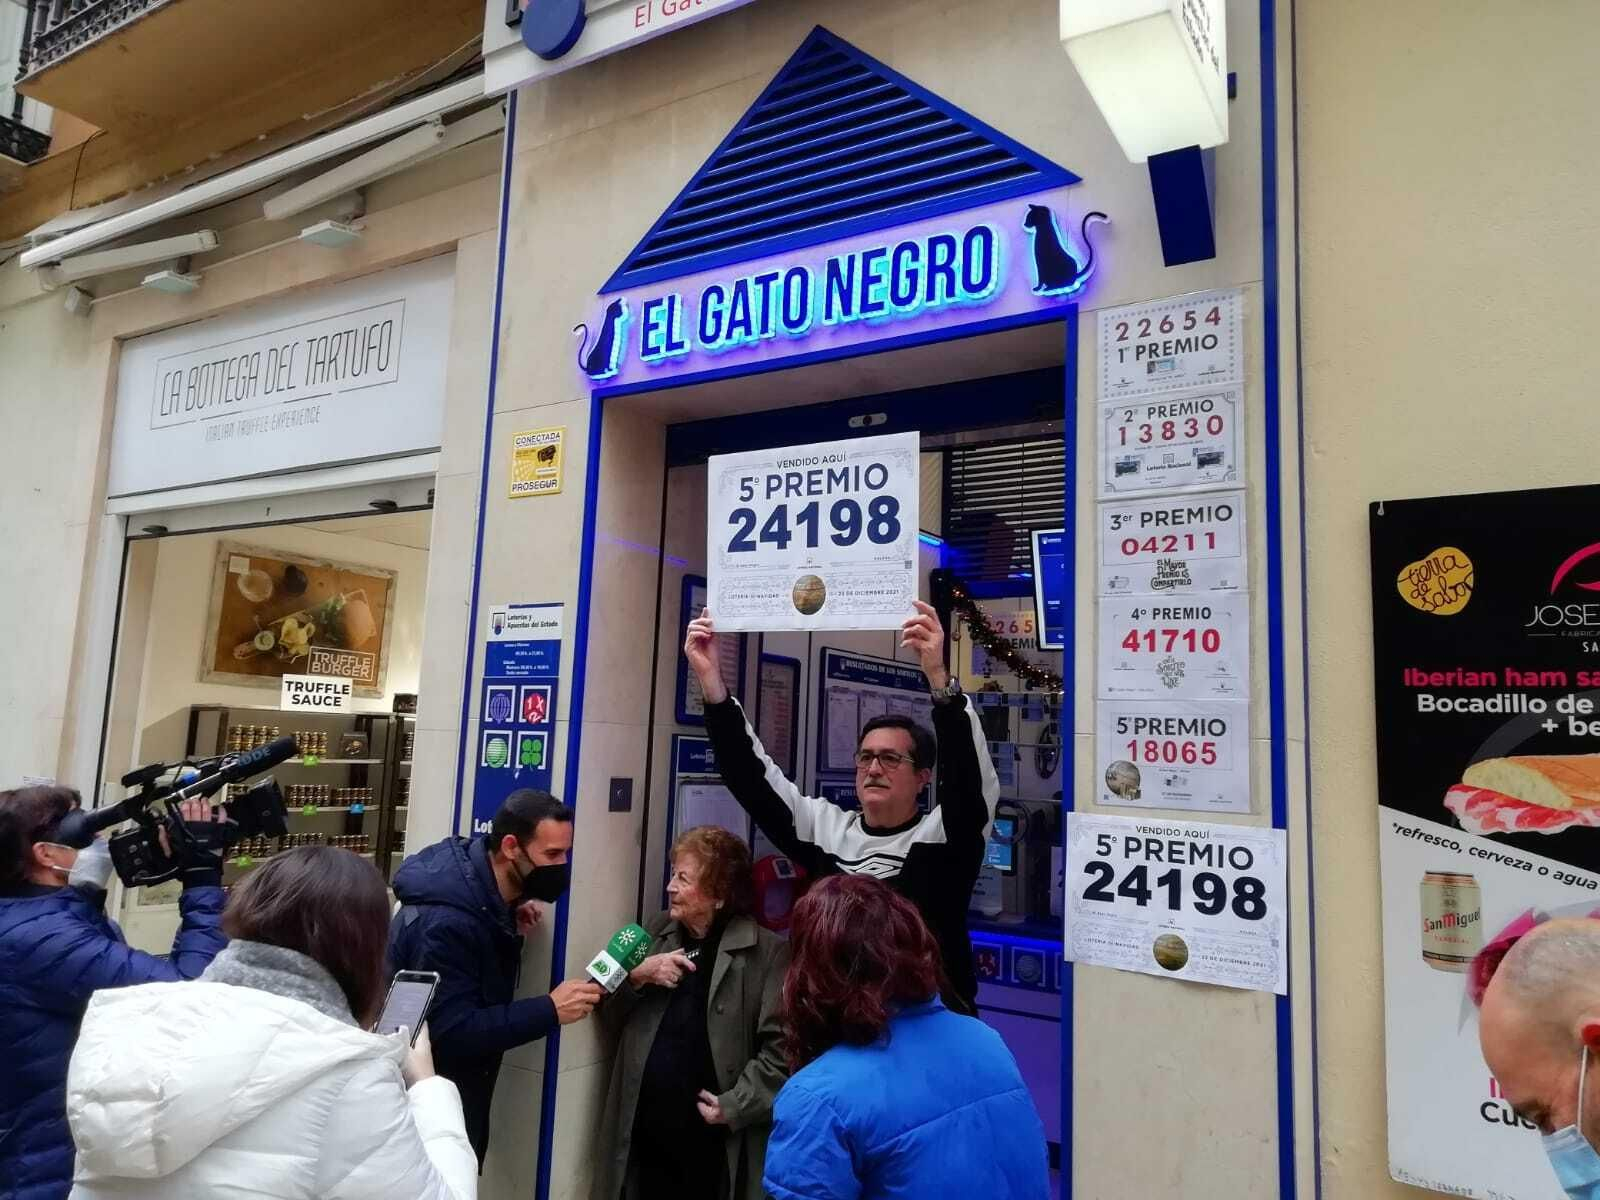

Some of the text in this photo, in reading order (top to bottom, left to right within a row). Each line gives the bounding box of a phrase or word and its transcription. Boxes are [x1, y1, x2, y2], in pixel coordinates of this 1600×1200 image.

[634, 0, 652, 28] El
[641, 225, 993, 358] EL GATO NEGRO
[1115, 306, 1221, 342] 22654
[1135, 333, 1219, 361] PREMIO
[185, 352, 260, 411] BOTTEGA
[264, 342, 299, 394] DEL
[305, 319, 393, 386] TARTUFO
[1147, 399, 1214, 420] PREMIO
[515, 431, 560, 445] CONECTADA
[1118, 414, 1224, 446] 13830
[776, 456, 819, 470] VENDIDO
[512, 479, 557, 492] PROSEGUR
[766, 462, 888, 499] PREMIO
[727, 495, 901, 553] 24198
[1141, 504, 1233, 528] PREMIO
[1121, 532, 1215, 556] 04211
[1402, 554, 1469, 587] tierra
[1152, 606, 1212, 620] PREMIO
[1122, 628, 1221, 653] 41710
[311, 651, 371, 669] TRUFFLE
[311, 661, 369, 678] BURGER
[285, 680, 351, 695] TRUFFLE
[1404, 667, 1496, 688] Iberian
[1505, 667, 1568, 688] ham
[291, 694, 343, 707] SAUCE
[1417, 694, 1594, 714] Bocadillo de
[1133, 716, 1226, 737] PREMIO
[1127, 739, 1217, 765] 18065
[1135, 824, 1210, 840] VENDIDO AQUÍ
[1124, 836, 1254, 871] PREMIO
[1468, 846, 1533, 872] cerveza
[1537, 865, 1549, 876] o
[1553, 870, 1598, 891] agua
[1081, 860, 1268, 921] 24198
